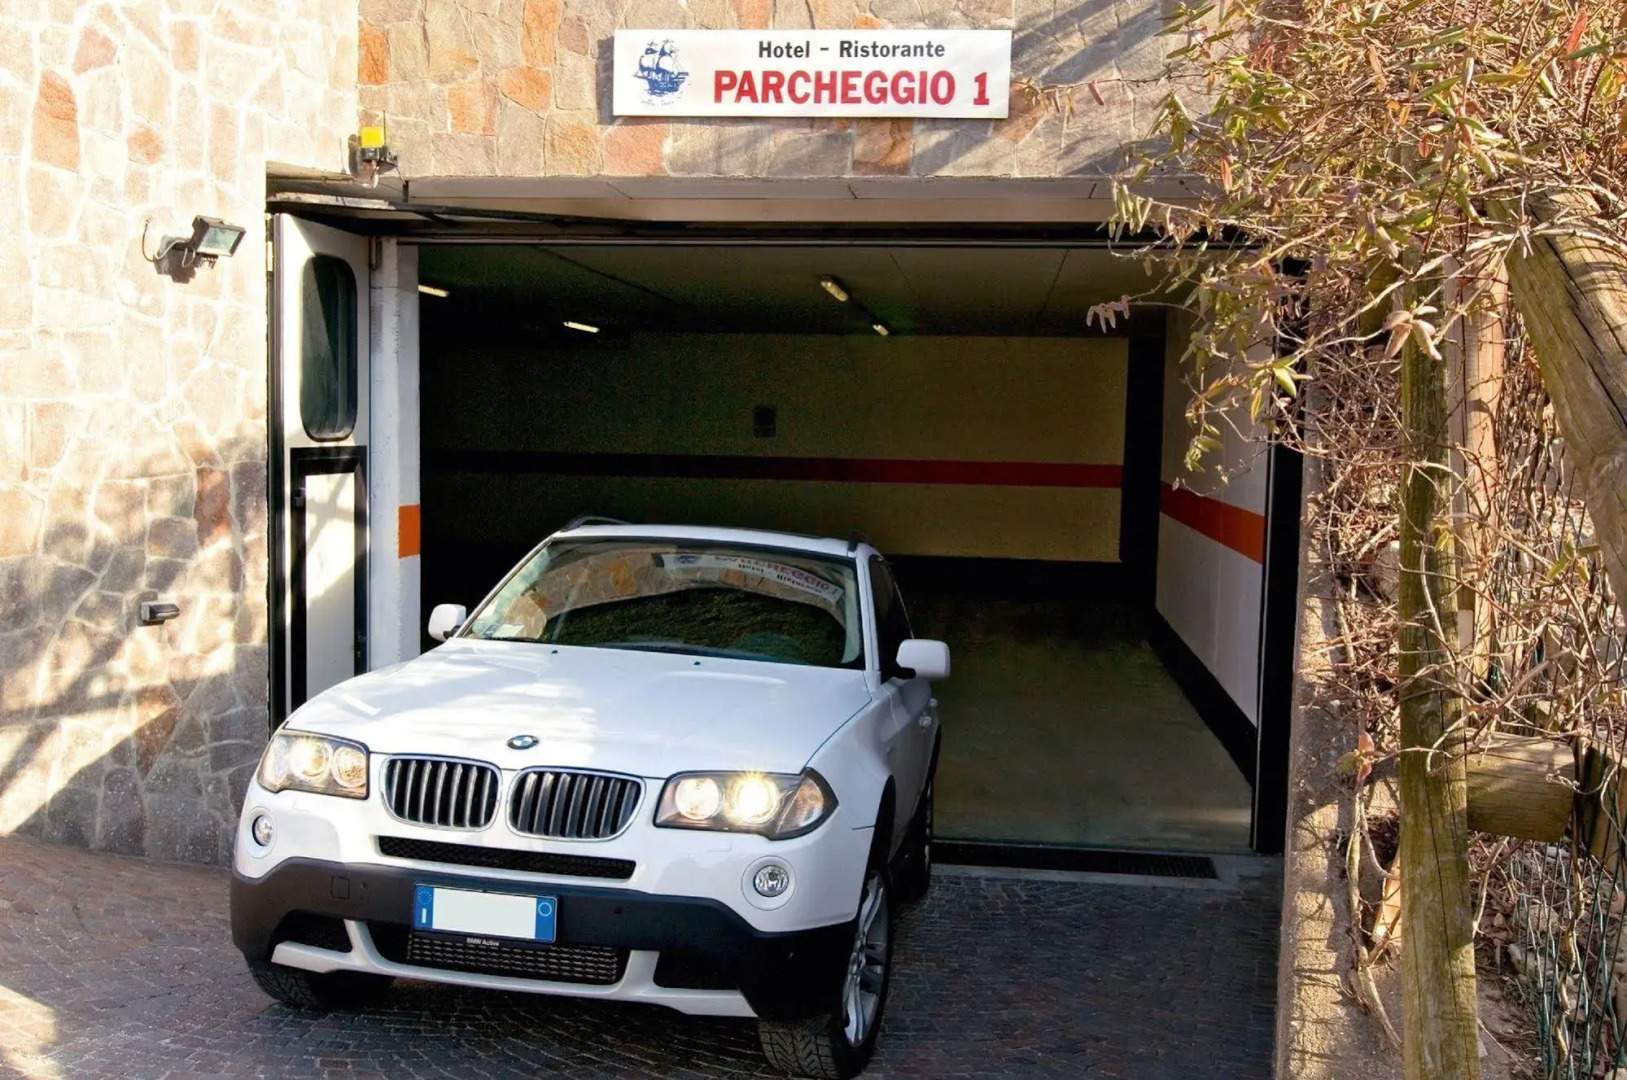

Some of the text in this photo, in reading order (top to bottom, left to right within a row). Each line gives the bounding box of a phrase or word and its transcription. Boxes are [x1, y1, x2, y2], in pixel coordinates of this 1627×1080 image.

[758, 40, 810, 58] Hotel
[839, 40, 945, 58] Ristorante
[713, 70, 990, 106] PARCHEGGIO 1
